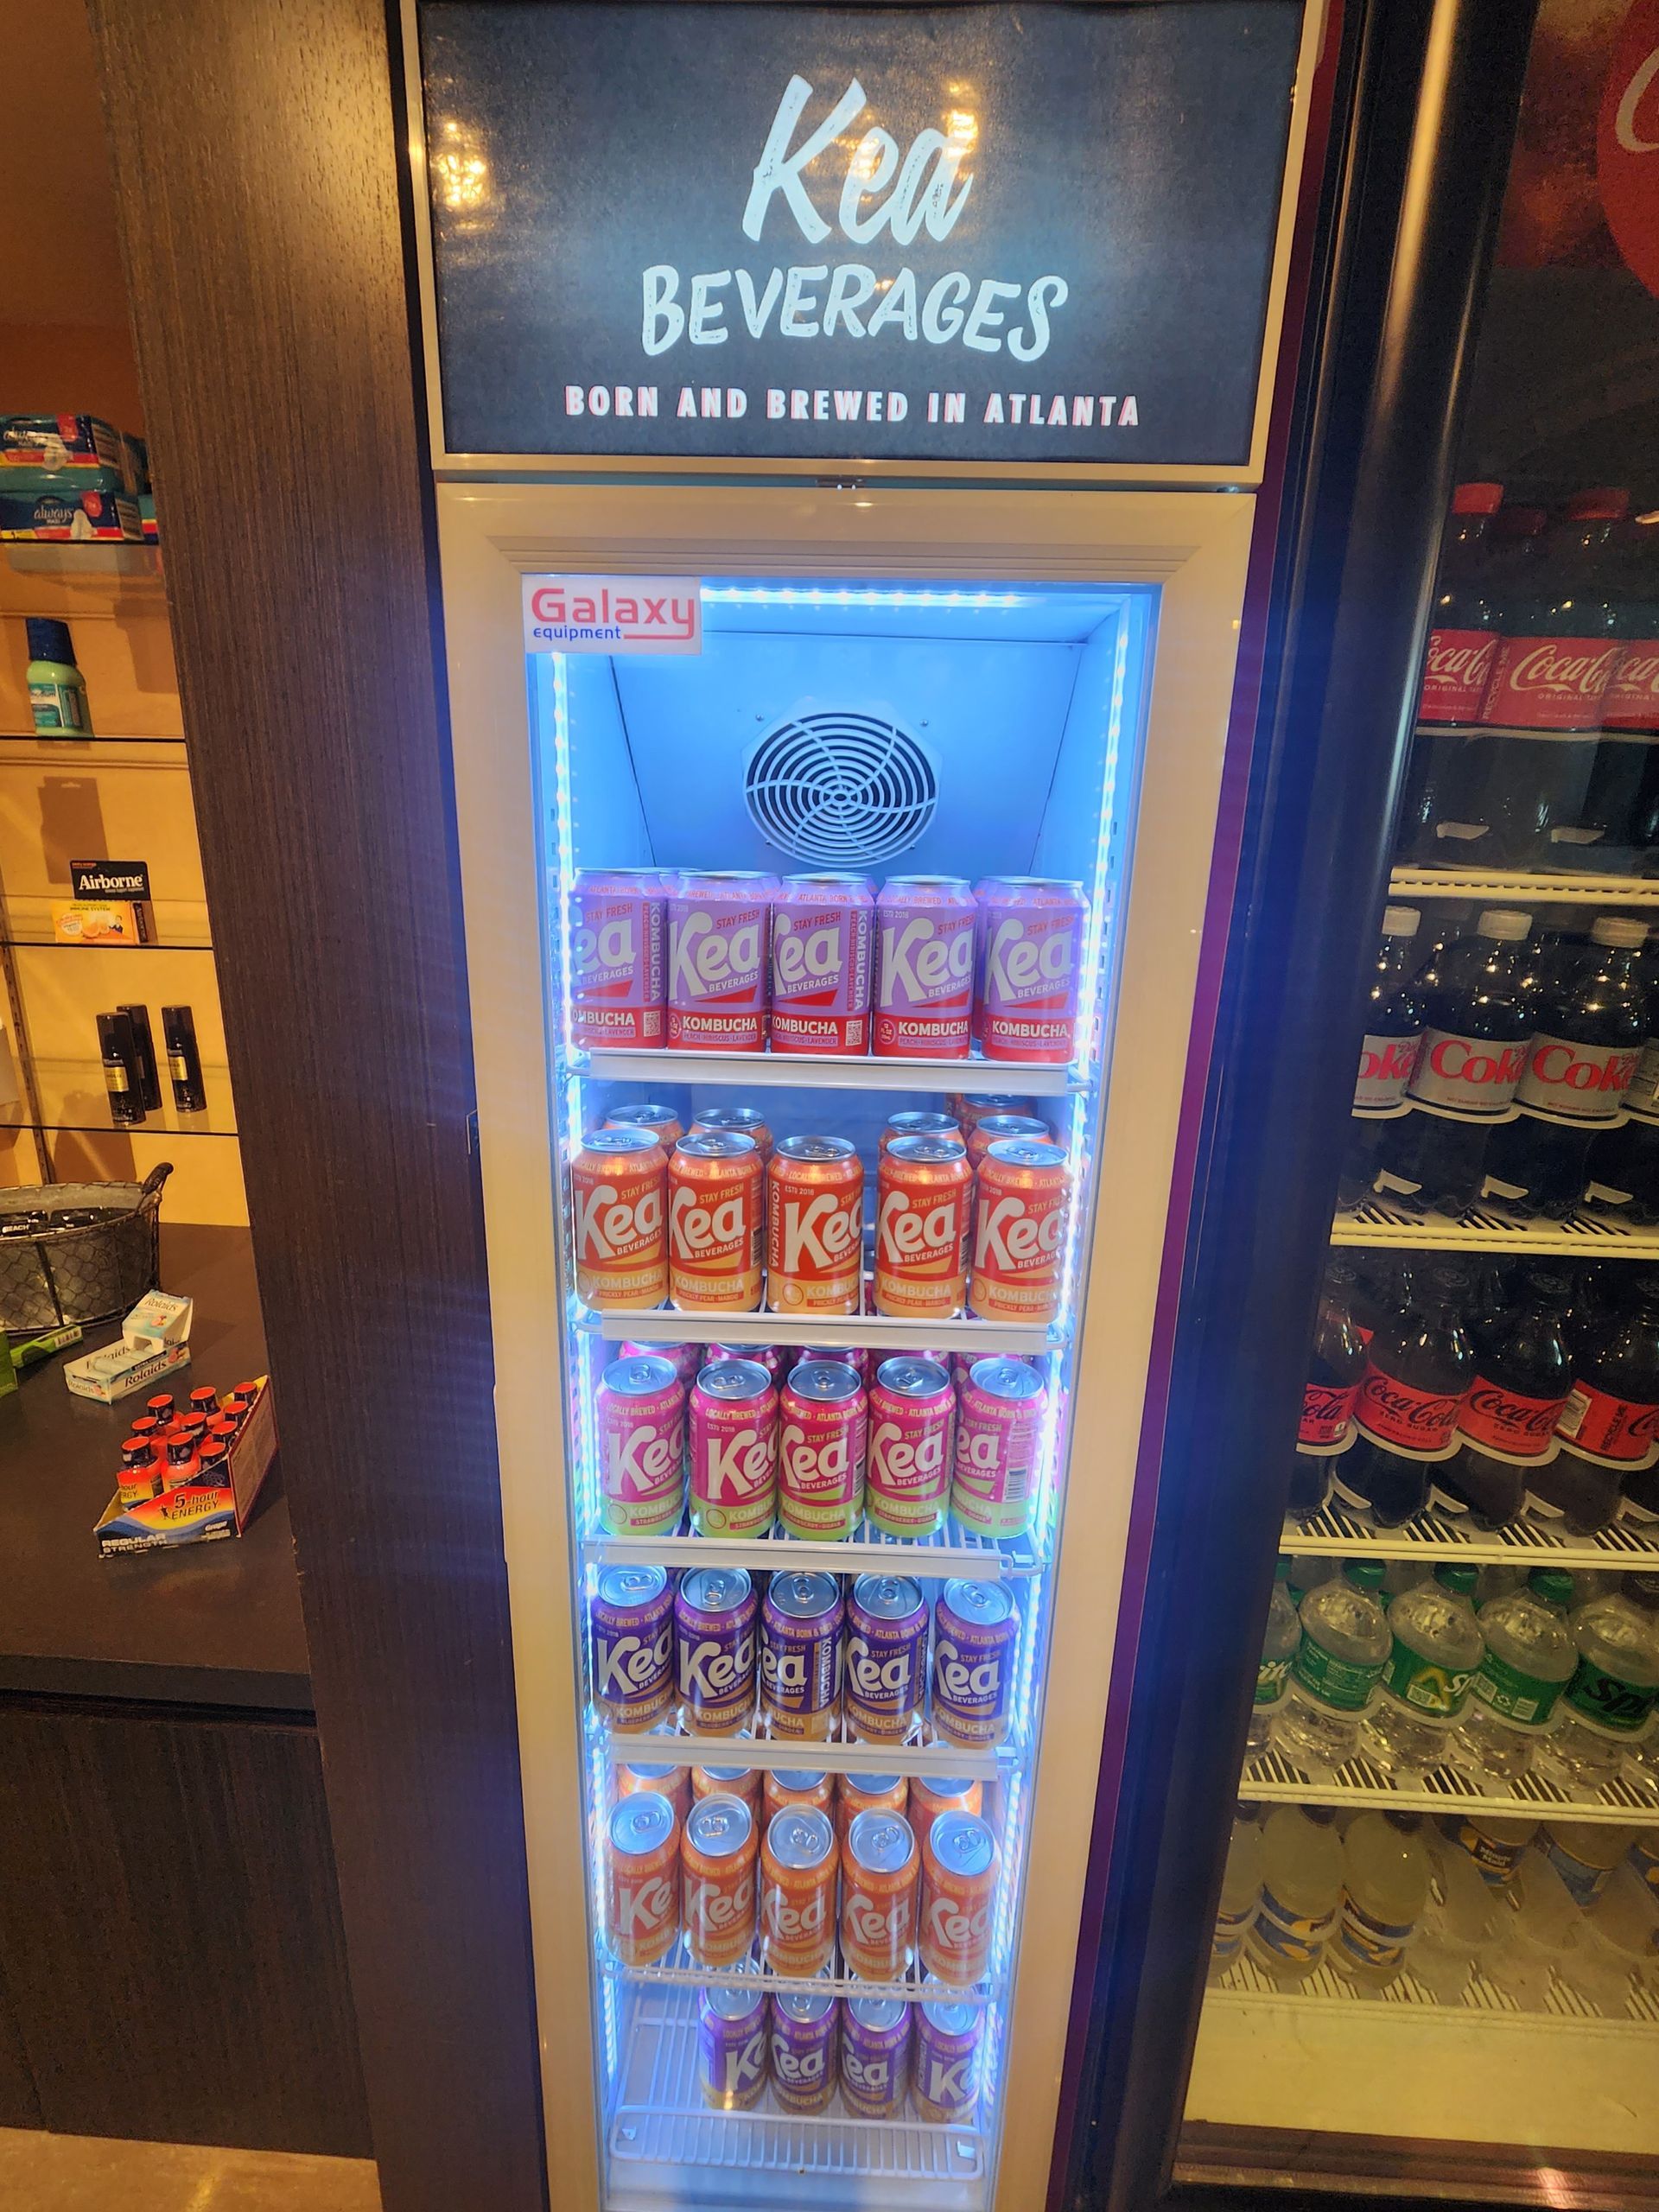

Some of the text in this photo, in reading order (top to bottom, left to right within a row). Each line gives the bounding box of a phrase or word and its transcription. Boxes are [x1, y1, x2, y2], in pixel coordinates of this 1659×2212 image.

[741, 74, 973, 245] Kea
[642, 264, 1068, 361] BEVERAGES
[564, 385, 1140, 426] BORN AND BREWED IN ATLANTA
[34, 507, 73, 524] always
[531, 588, 695, 639] Galaxy
[532, 626, 622, 642] equipment
[79, 874, 143, 891] Airborne
[586, 903, 633, 923] STAY FRESH
[716, 909, 760, 929] STAY FRESH
[793, 912, 841, 931] STAY FRESH
[938, 915, 976, 936] STAY FRESH
[1027, 916, 1074, 936] STAY FRESH
[650, 901, 662, 1001] KOMBUCHA
[669, 912, 760, 1001] Kea
[855, 910, 868, 1010] KOMBUCHA
[880, 918, 973, 1007] Kea
[983, 918, 1073, 1005] Kea
[582, 966, 633, 984] BEVERAGES
[709, 970, 759, 993] BEVERAGES
[787, 974, 839, 994] BEVERAGES
[928, 976, 971, 998] BEVERAGES
[1018, 978, 1070, 998] BEVERAGES
[683, 1016, 758, 1032] KOMBUCHA
[899, 1020, 968, 1036] KOMBUCHA
[993, 1020, 1067, 1037] KOMBUCHA
[621, 1187, 640, 1199] STAY
[700, 1183, 745, 1205] STAY FRESH
[912, 1189, 957, 1209] STAY FRESH
[1028, 1204, 1047, 1215] STAY
[575, 1185, 664, 1259] Kea
[669, 1185, 746, 1259] Kea
[770, 1180, 780, 1268] KOMBUCHA
[617, 1229, 663, 1255] BEVERAGES
[975, 1197, 1065, 1271] Kea
[695, 1236, 744, 1258] BEVERAGES
[904, 1243, 954, 1262] BEVERAGES
[593, 1269, 662, 1288] KOMBUCHA
[675, 1274, 744, 1293] KOMBUCHA
[881, 1278, 950, 1297] KOMBUCHA
[144, 1297, 178, 1312] Rolaids
[124, 1361, 167, 1388] Rolaids
[905, 1430, 923, 1440] STAY
[978, 1421, 1003, 1432] FRESH
[807, 1433, 824, 1444] STAY
[868, 1421, 944, 1486] Kea
[801, 1471, 847, 1490] BEVERAGES
[896, 1466, 941, 1485] BEVERAGES
[175, 1491, 219, 1510] 5-hour
[171, 1500, 220, 1522] ENERGY
[102, 1533, 167, 1548] REGULAR
[103, 1540, 168, 1554] STRENGTH
[875, 1629, 899, 1640] ATLANTA
[784, 1643, 805, 1652] FRESH
[871, 1643, 912, 1659] STAY FRESH
[680, 1633, 753, 1699] Kea
[960, 1654, 978, 1663] STAY
[819, 1637, 832, 1708] KOMBUCHA
[766, 1682, 804, 1694] BEVERAGES
[864, 1685, 908, 1700] BEVERAGES
[953, 1692, 997, 1704] BEVERAGES
